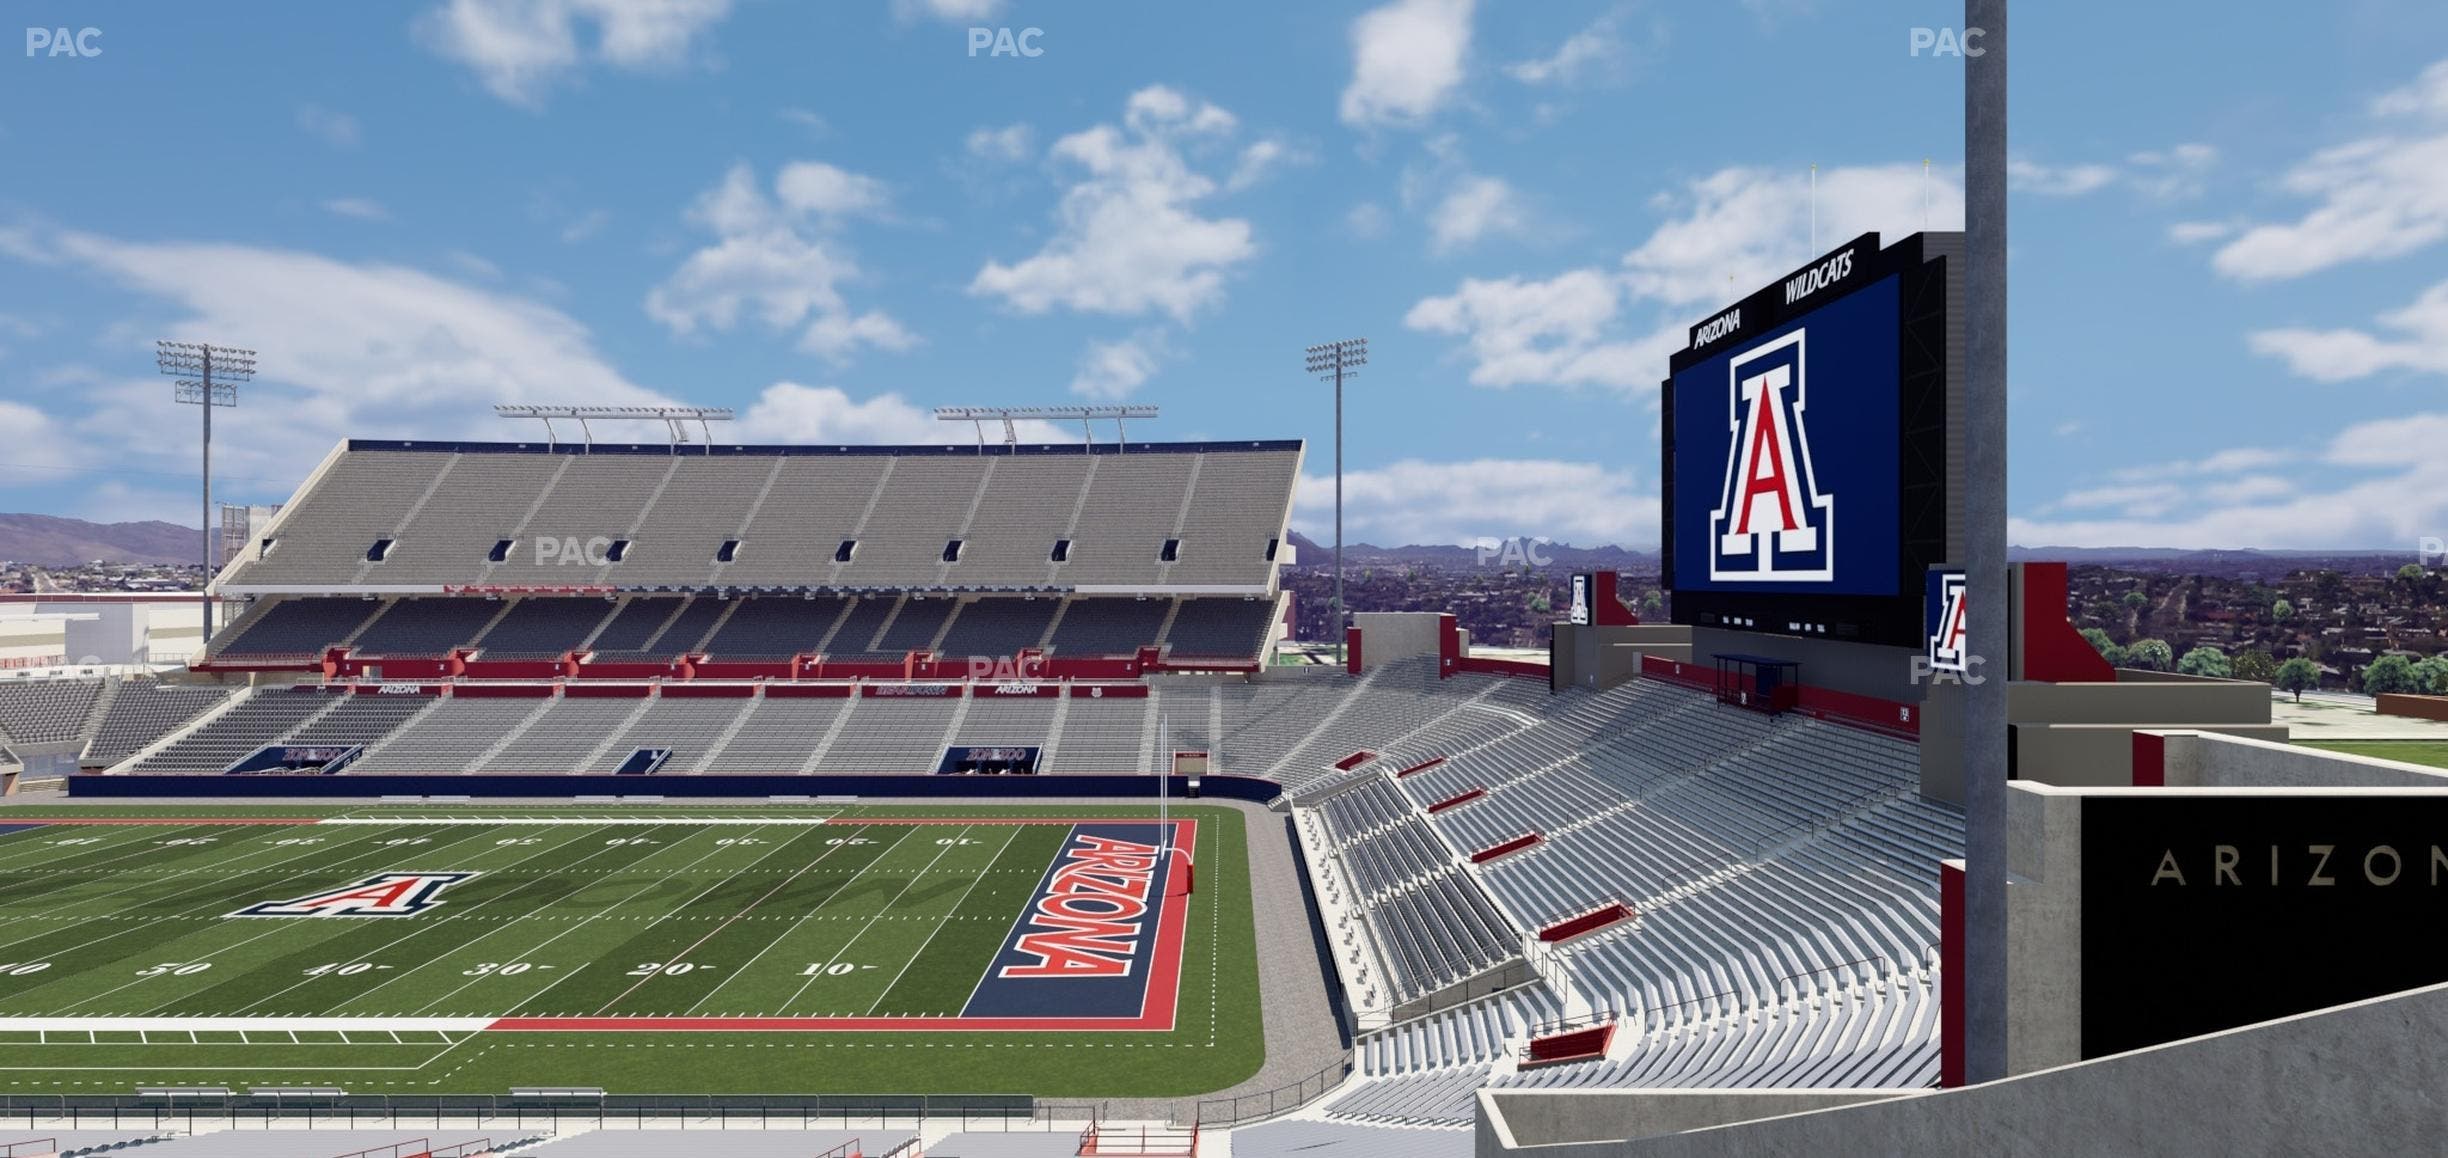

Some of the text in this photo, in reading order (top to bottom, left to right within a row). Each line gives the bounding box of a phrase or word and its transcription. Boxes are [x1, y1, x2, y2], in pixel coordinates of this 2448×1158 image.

[1786, 249, 1854, 305] WILDCATS
[1694, 308, 1740, 350] ARIZONA
[378, 684, 420, 694] ARIZONA
[994, 684, 1037, 694] ARIZONA
[998, 834, 1160, 978] ARIZONA
[136, 963, 212, 975] 50
[302, 963, 373, 975] 40
[462, 963, 531, 975] 30
[626, 963, 694, 975] 20
[796, 963, 855, 975] 10
